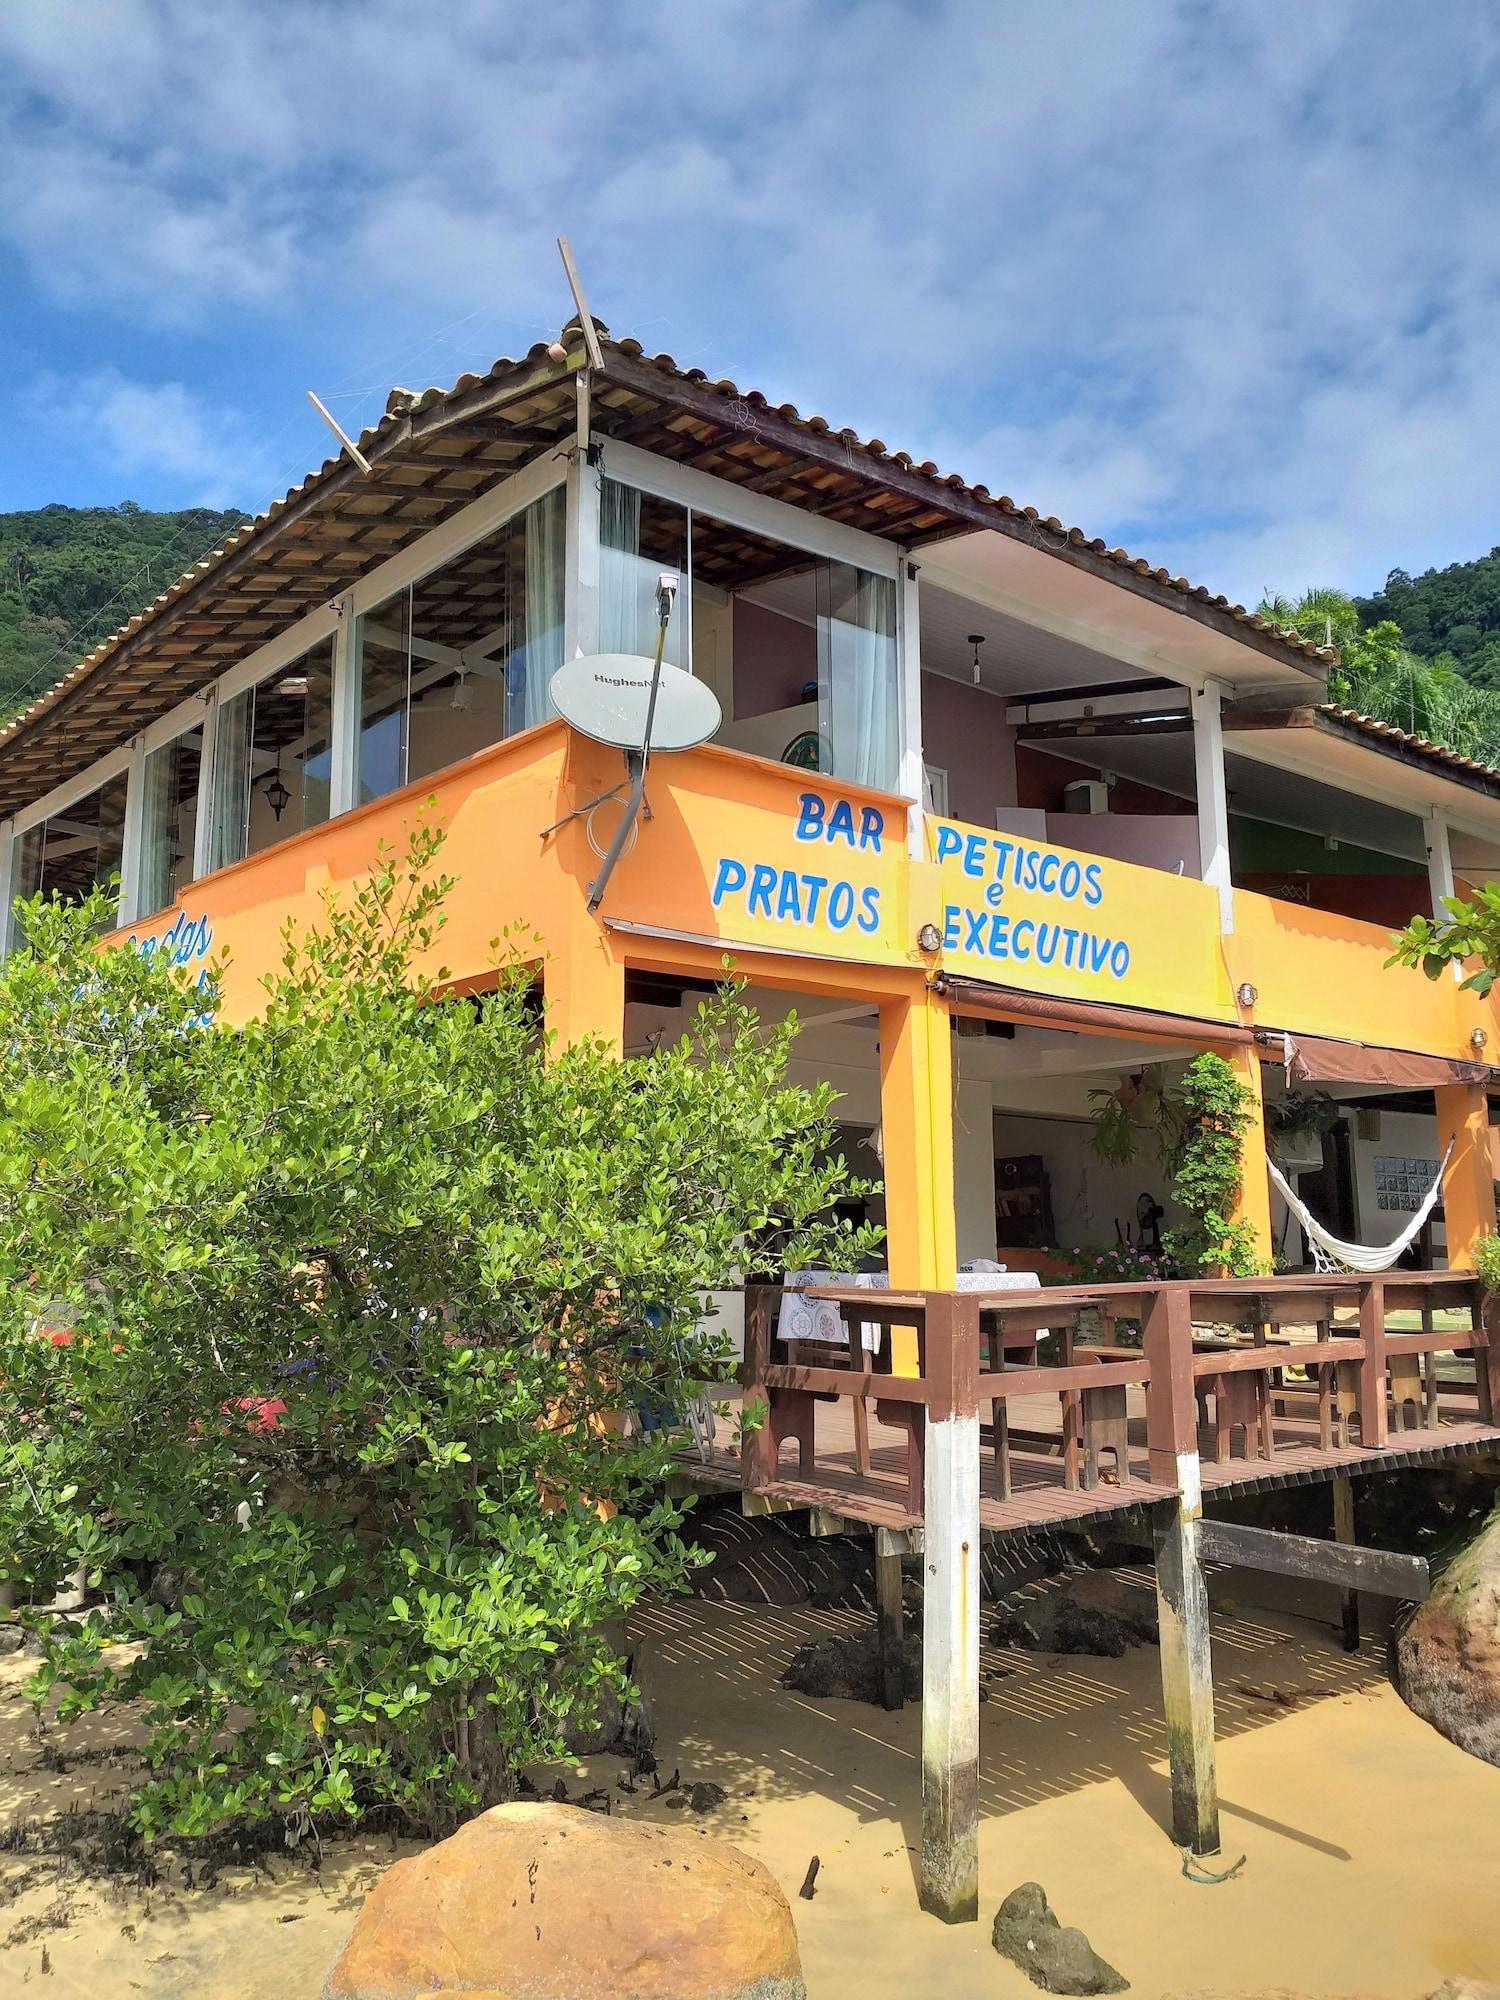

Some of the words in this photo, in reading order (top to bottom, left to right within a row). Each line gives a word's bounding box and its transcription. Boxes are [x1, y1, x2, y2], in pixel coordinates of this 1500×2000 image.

[593, 674, 667, 687] HughesNt
[797, 793, 885, 852] BAR
[712, 858, 880, 932] PRATOS
[937, 825, 1104, 905] PETISCOS
[986, 882, 1002, 906] e
[943, 904, 1130, 978] EXECUTIVO
